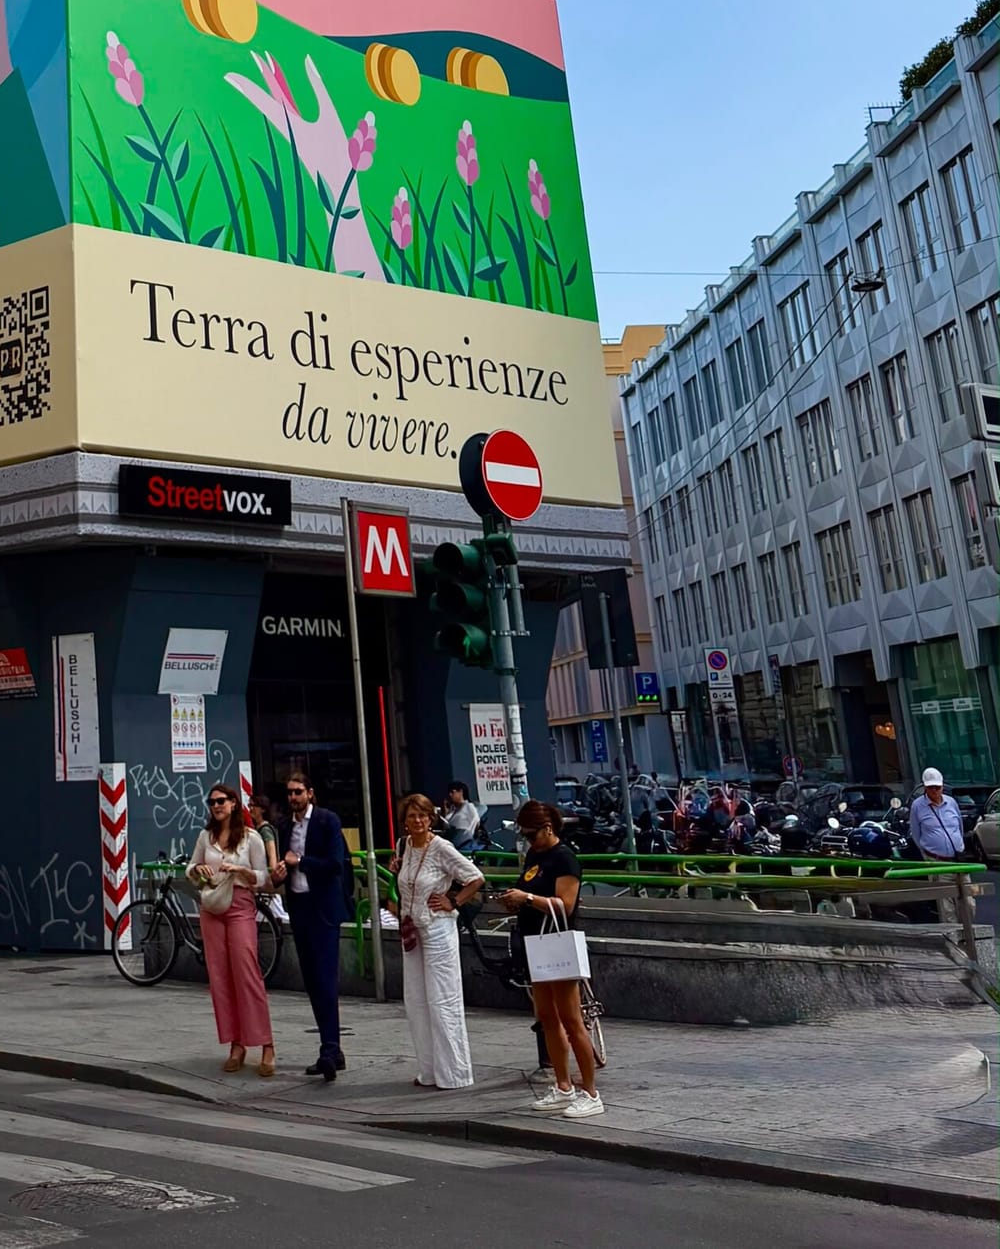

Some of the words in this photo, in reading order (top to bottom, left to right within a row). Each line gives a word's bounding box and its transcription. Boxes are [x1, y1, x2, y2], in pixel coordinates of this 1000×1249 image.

[130, 280, 274, 361] Terra
[290, 311, 335, 371] di
[350, 336, 569, 406] esperienze
[282, 383, 332, 445] da
[346, 392, 458, 459] vivere.
[364, 525, 409, 578] M
[164, 661, 216, 671] BELLUSCHI
[643, 676, 652, 689] P
[68, 654, 80, 755] BELLUSCHI
